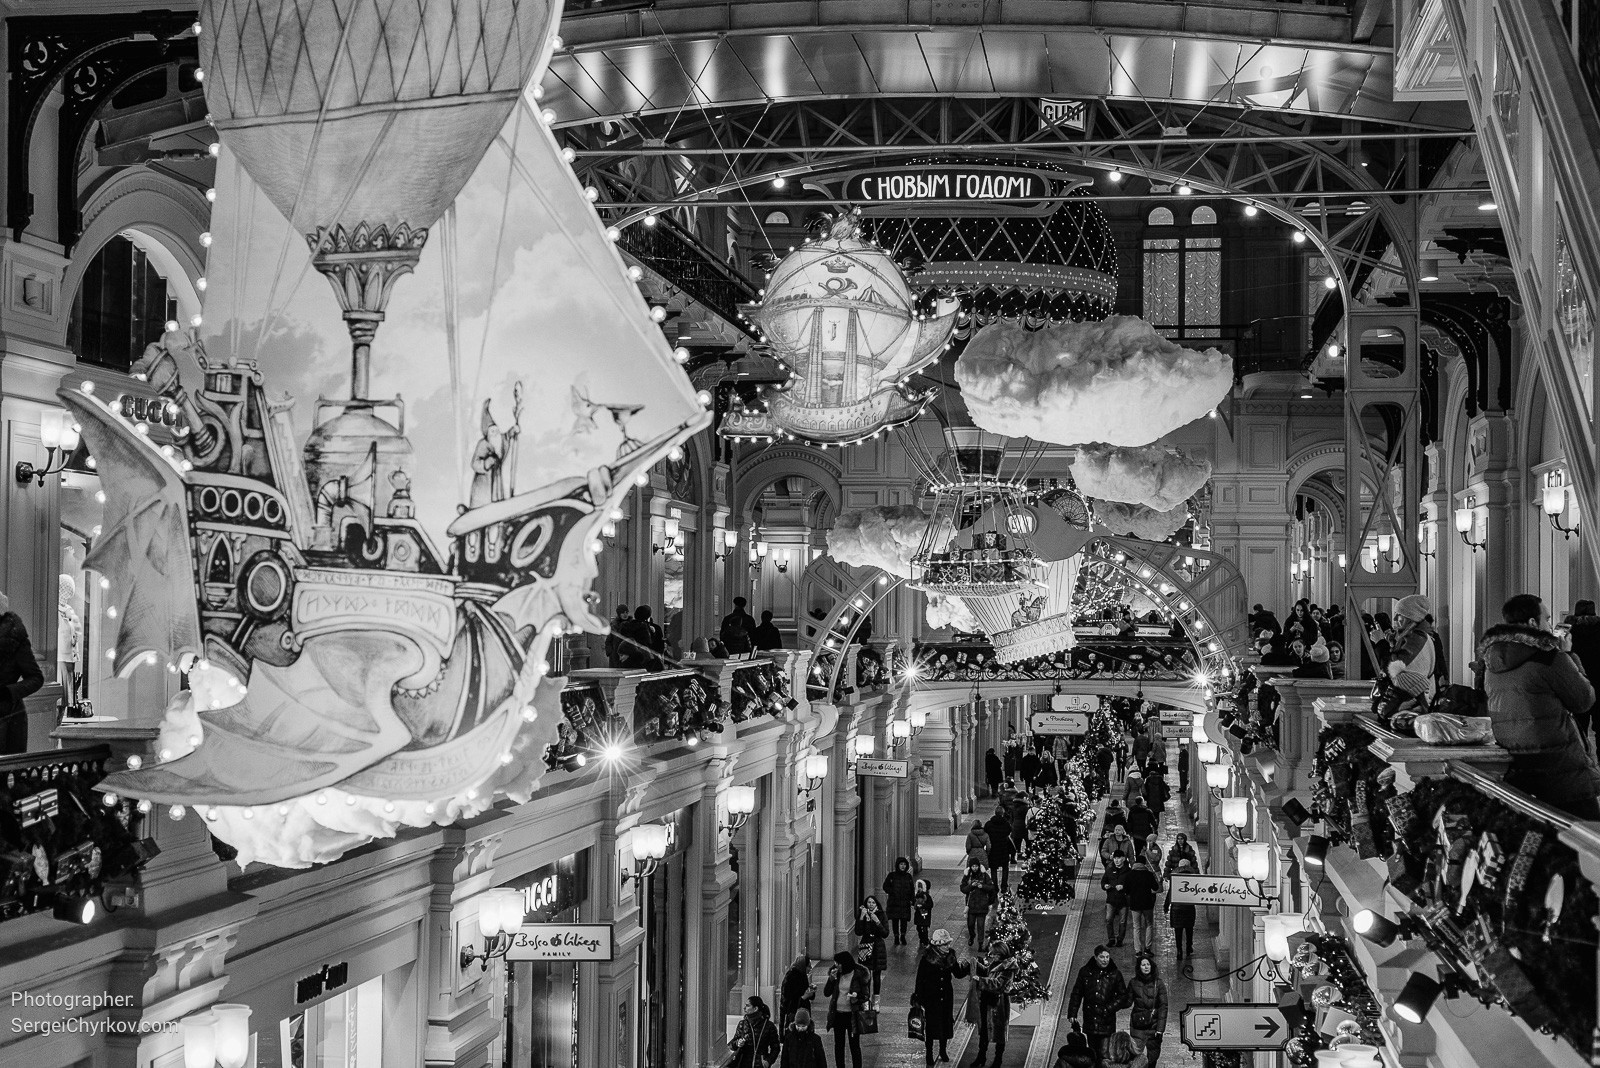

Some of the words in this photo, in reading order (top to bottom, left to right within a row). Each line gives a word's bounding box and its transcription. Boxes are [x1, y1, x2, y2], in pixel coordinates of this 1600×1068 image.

[861, 177, 872, 200] С
[877, 174, 950, 200] НОВЫМ
[956, 174, 1032, 199] ГОДОМ!
[521, 874, 558, 917] UCCI
[1178, 881, 1206, 896] Bosco
[515, 932, 548, 950] Bosco
